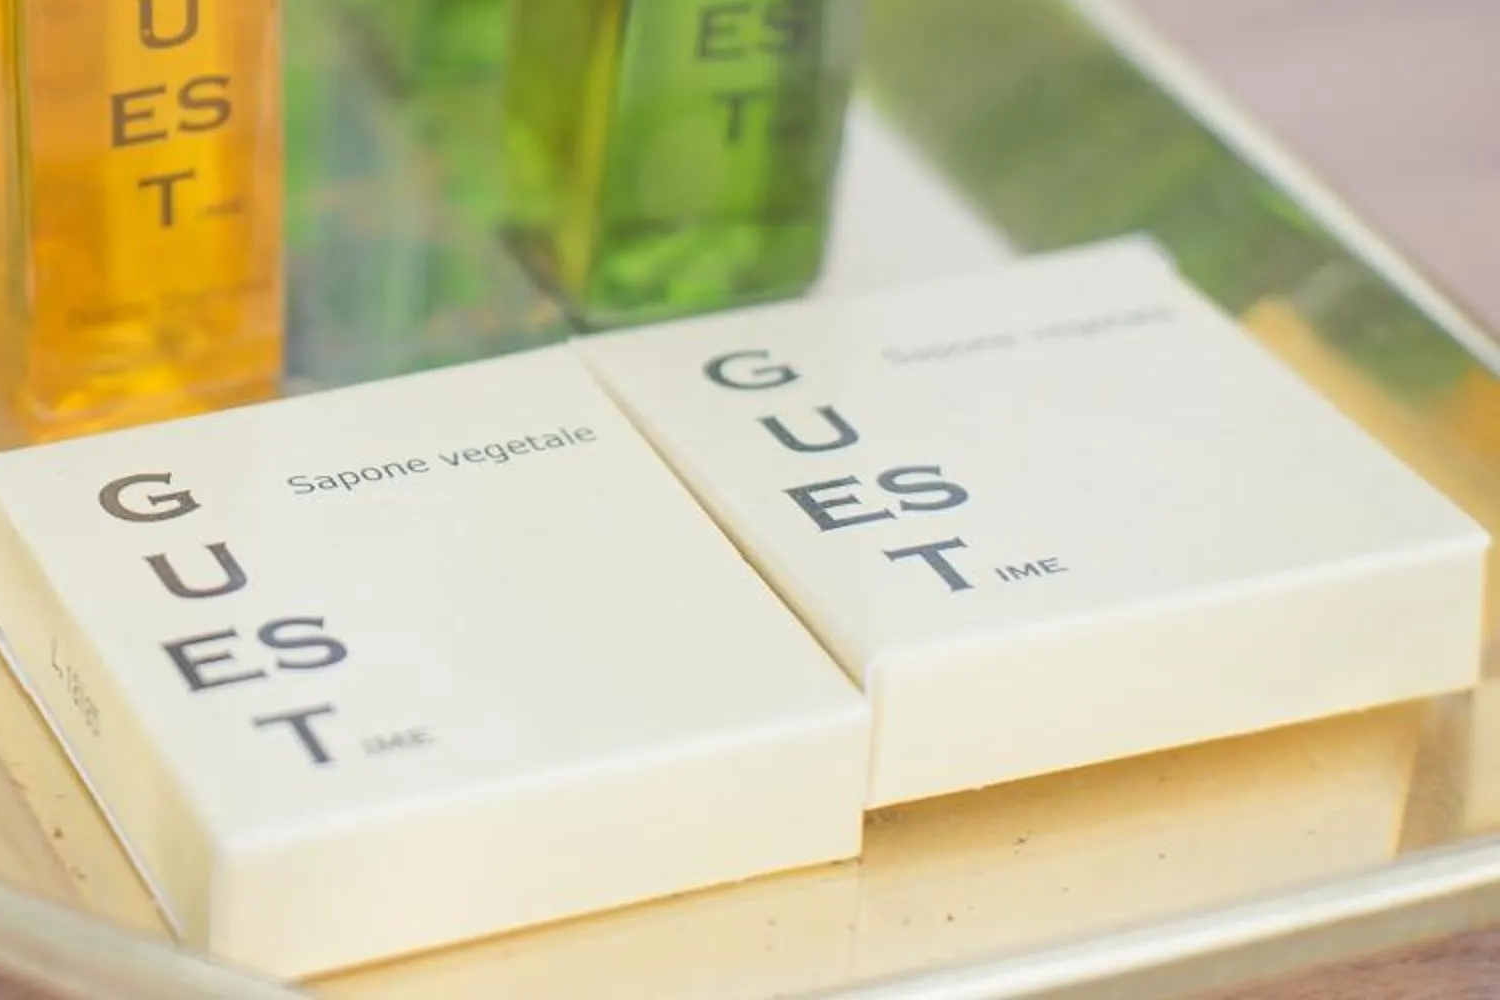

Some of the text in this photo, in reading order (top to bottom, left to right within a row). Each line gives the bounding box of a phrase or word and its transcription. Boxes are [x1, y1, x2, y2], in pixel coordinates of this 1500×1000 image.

[109, 75, 233, 149] ES
[137, 169, 197, 229] T
[702, 349, 800, 390] G
[756, 405, 860, 453] U
[286, 425, 597, 496] Sapone vegetale
[97, 472, 201, 523] G
[782, 465, 970, 532] ES
[144, 541, 248, 599] U
[882, 536, 1069, 593] T IME
[161, 617, 348, 692] ES
[252, 703, 335, 766] T
